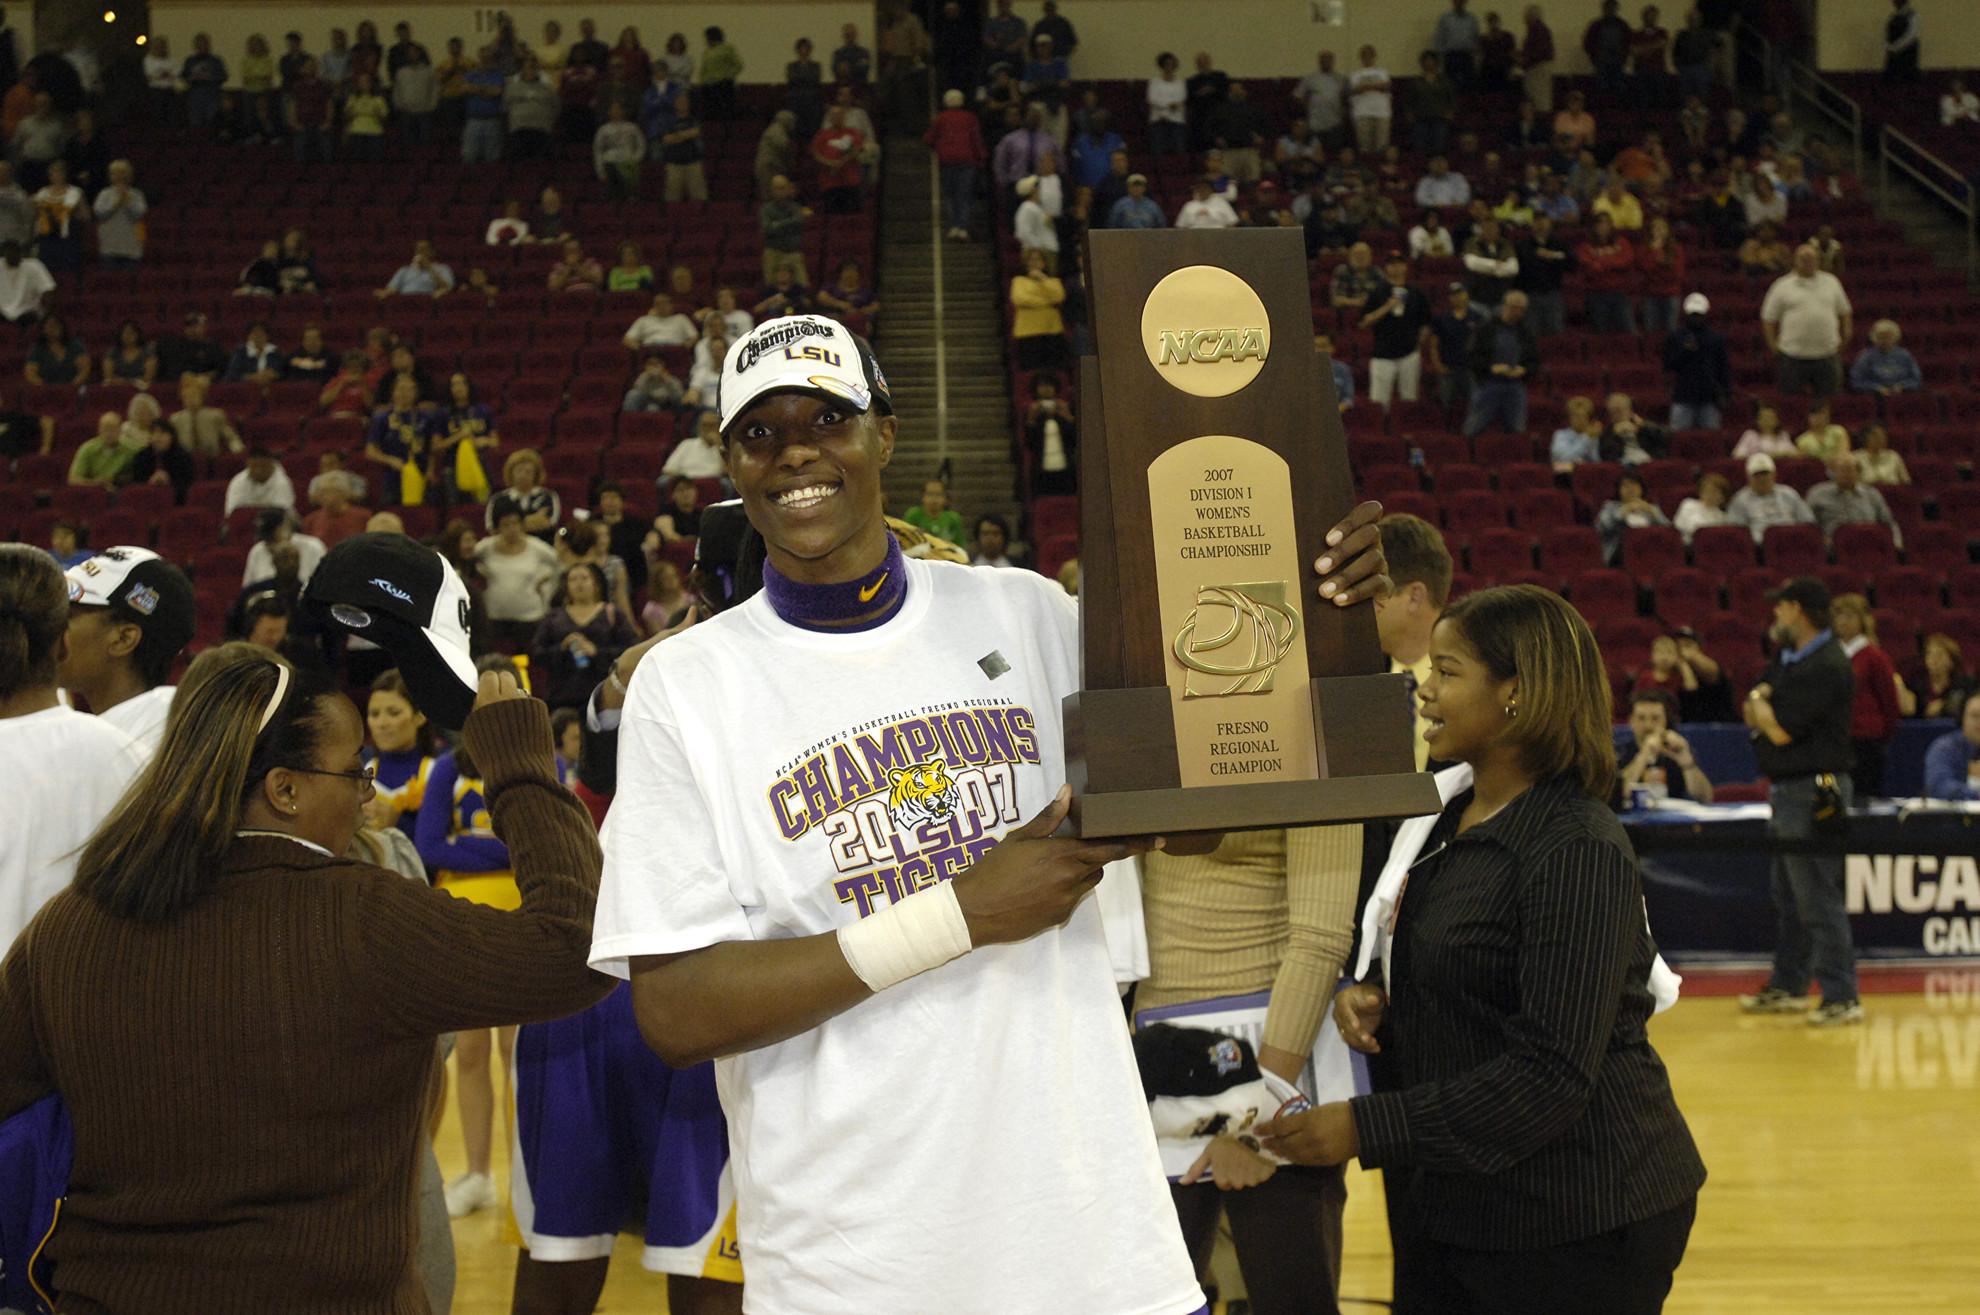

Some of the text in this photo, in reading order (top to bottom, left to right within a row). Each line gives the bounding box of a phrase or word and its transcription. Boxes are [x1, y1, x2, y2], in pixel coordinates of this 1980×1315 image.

[1159, 328, 1268, 365] NCAA
[784, 346, 842, 368] LSU
[1204, 469, 1234, 482] 2007
[1190, 487, 1252, 501] DIVISION I
[1195, 506, 1250, 520] WOMEN'S
[1183, 525, 1266, 540] BASKETBALL
[1180, 543, 1272, 559] CHAMPIONSHIP
[803, 730, 848, 758] WOMEN'S
[852, 709, 917, 735] BASKETBALL
[921, 701, 959, 714] FRESNO
[964, 697, 1013, 707] REGIONAL
[1217, 720, 1269, 736] FRESNO
[1210, 739, 1280, 756] REGIONAL
[766, 705, 1042, 842] CHAMPIONS
[1210, 758, 1282, 775] CHAMPION
[888, 808, 985, 865] LSU
[719, 1237, 740, 1260] LS
